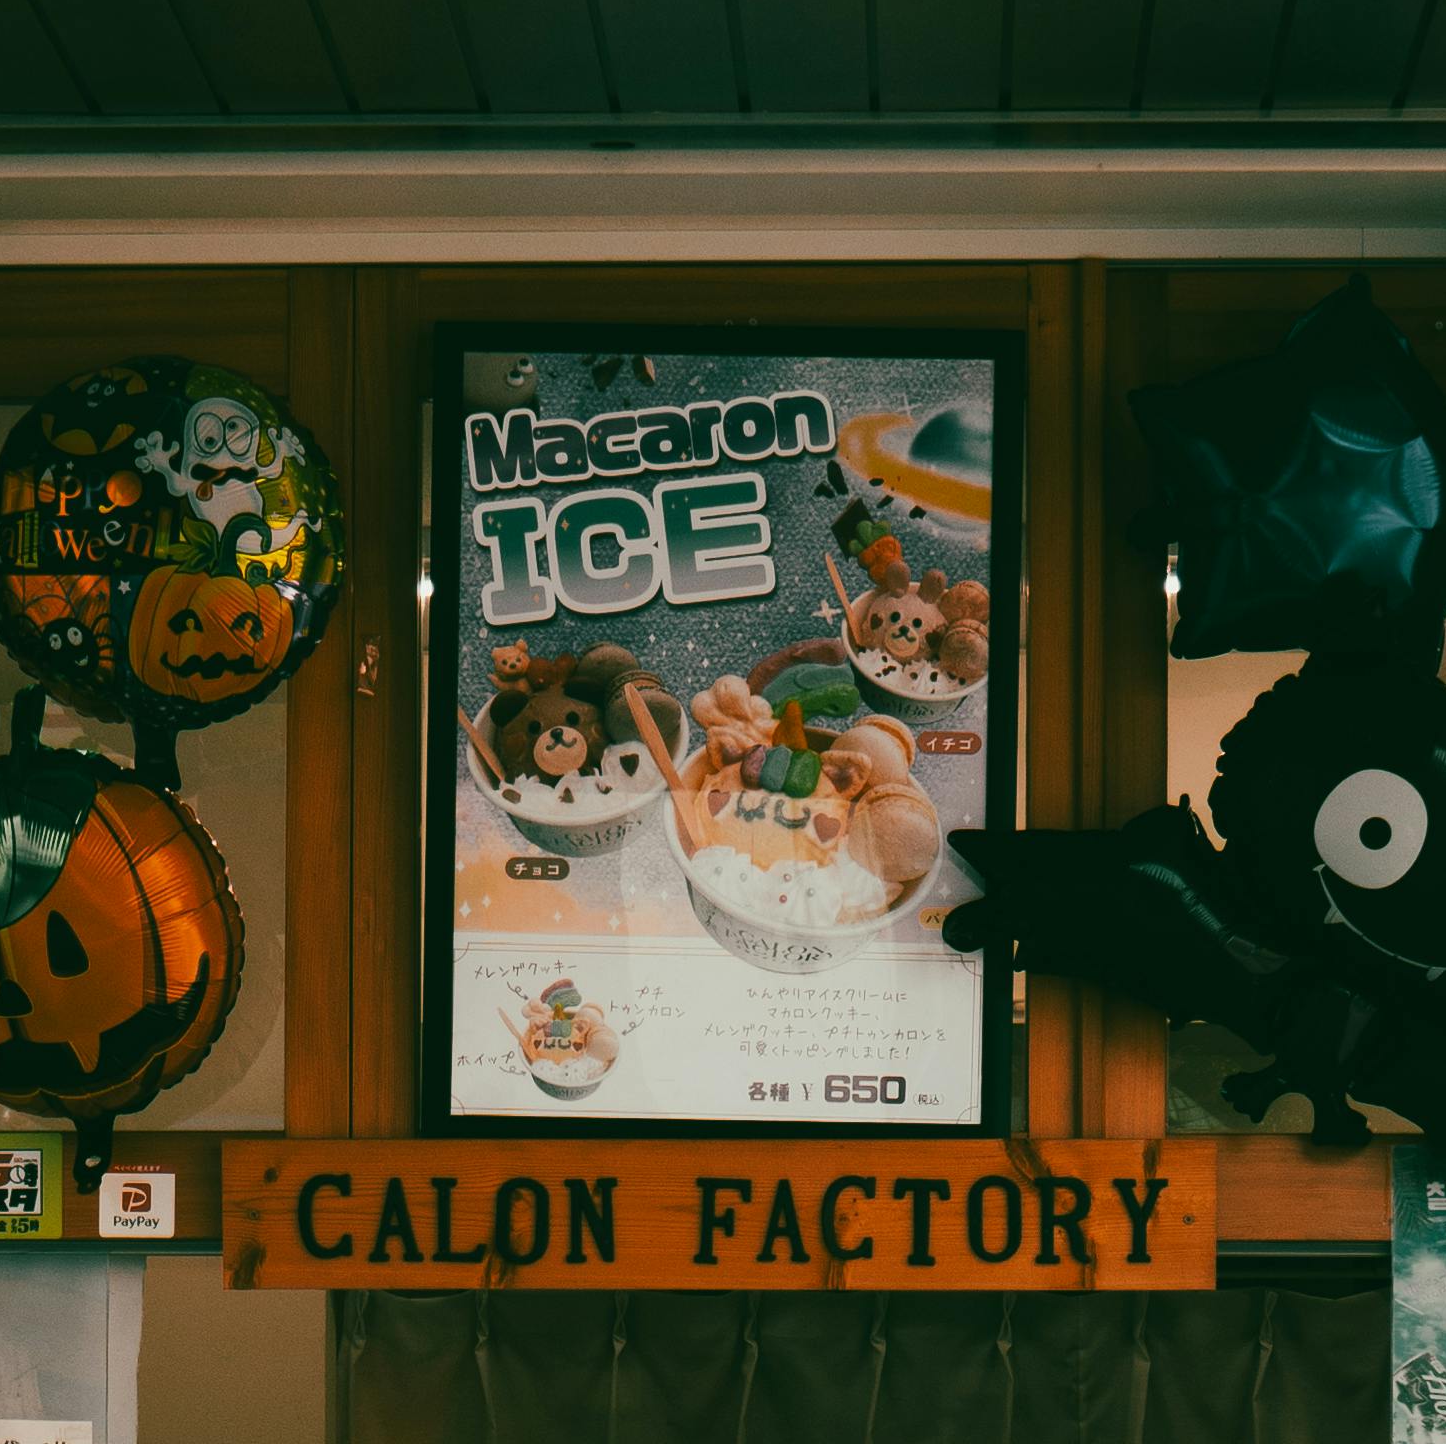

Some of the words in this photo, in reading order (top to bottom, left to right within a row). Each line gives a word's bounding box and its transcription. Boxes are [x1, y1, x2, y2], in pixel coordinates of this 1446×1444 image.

[466, 390, 836, 492] Macaron
[473, 472, 775, 626] ICE
[925, 736, 973, 752] イチゴ
[513, 861, 561, 877] チョコ
[474, 959, 578, 978] メレンゲクッキー
[747, 987, 907, 1002] ひんやりアイスクリームに
[457, 1050, 516, 1066] ホイップ
[748, 1082, 790, 1102] 各種
[824, 1074, 907, 1105] 650
[113, 1215, 160, 1229] PayPay
[297, 1172, 621, 1266] CALON
[693, 1173, 1170, 1268] FACTORY
